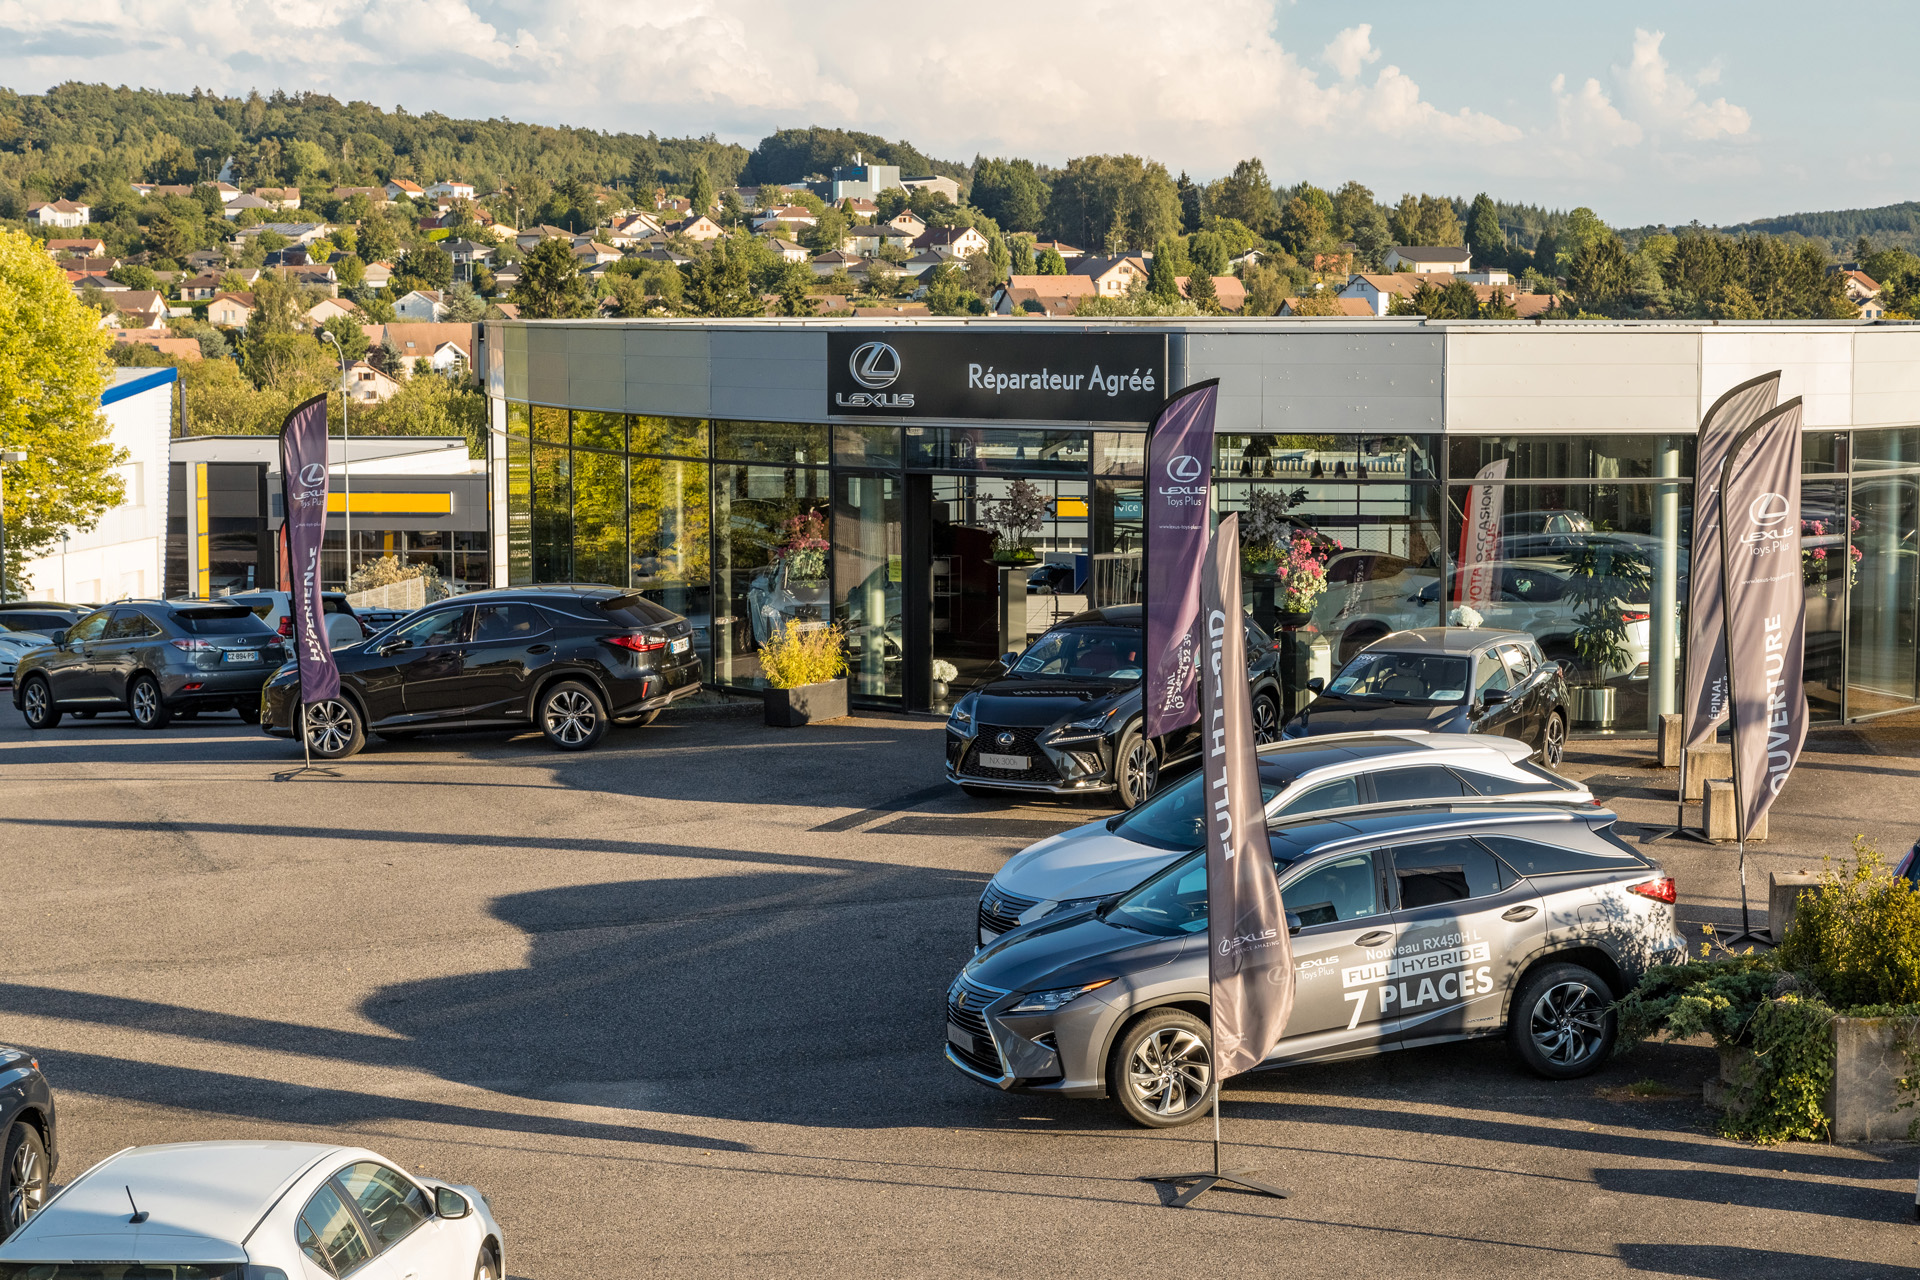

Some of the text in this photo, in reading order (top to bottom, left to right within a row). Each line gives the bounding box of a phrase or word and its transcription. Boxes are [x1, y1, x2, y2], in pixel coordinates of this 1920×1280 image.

[968, 363, 1155, 397] Réparateur Agréé
[836, 392, 915, 408] LEXUS
[293, 489, 325, 500] LEXU
[1159, 486, 1207, 495] LEXUS
[1118, 502, 1138, 512] vice
[1166, 496, 1201, 508] Toys Plus
[1740, 525, 1794, 544] LEXUS
[1748, 540, 1790, 557] Toys Plus
[1708, 677, 1722, 720] ÉPINAL
[989, 757, 1000, 765] NX
[1213, 766, 1235, 861] FULL
[1366, 944, 1420, 961] Nouveau
[1423, 931, 1470, 950] RX450H
[1294, 955, 1339, 971] LEXUS
[1348, 946, 1484, 983] FULL HYBRIDE
[1300, 966, 1335, 981] Toys Plus
[1344, 966, 1494, 1031] 7 PLACES
